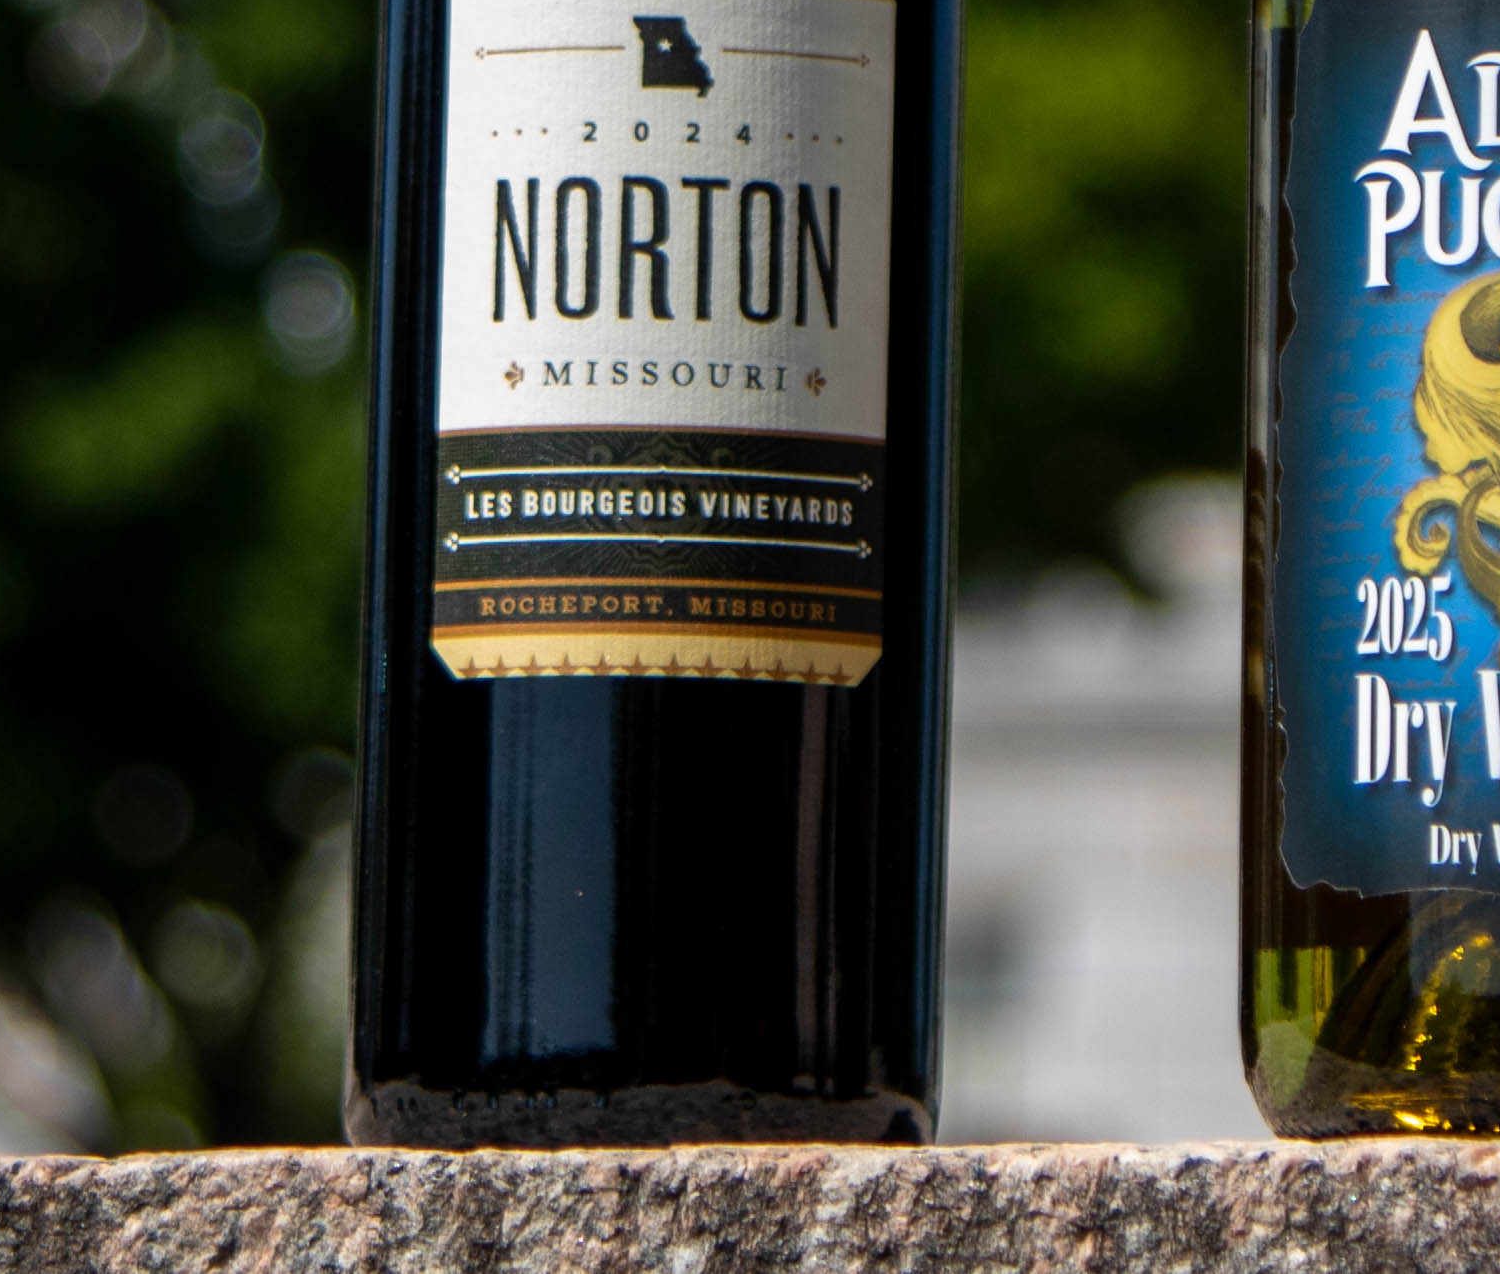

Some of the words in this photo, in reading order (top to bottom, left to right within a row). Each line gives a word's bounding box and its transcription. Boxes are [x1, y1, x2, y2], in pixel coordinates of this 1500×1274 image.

[582, 121, 754, 144] 2024
[493, 176, 841, 330] NORTON
[542, 360, 790, 393] MISSOURI
[465, 491, 513, 521] LES
[521, 489, 686, 520] BOURGEOIS
[699, 491, 854, 527] VINEYARDS
[480, 595, 674, 617] ROCHEPORT,
[689, 595, 837, 623] MISSOURI
[1356, 572, 1453, 662] 2025
[1353, 672, 1457, 808] Dry
[1429, 823, 1481, 868] Dry
